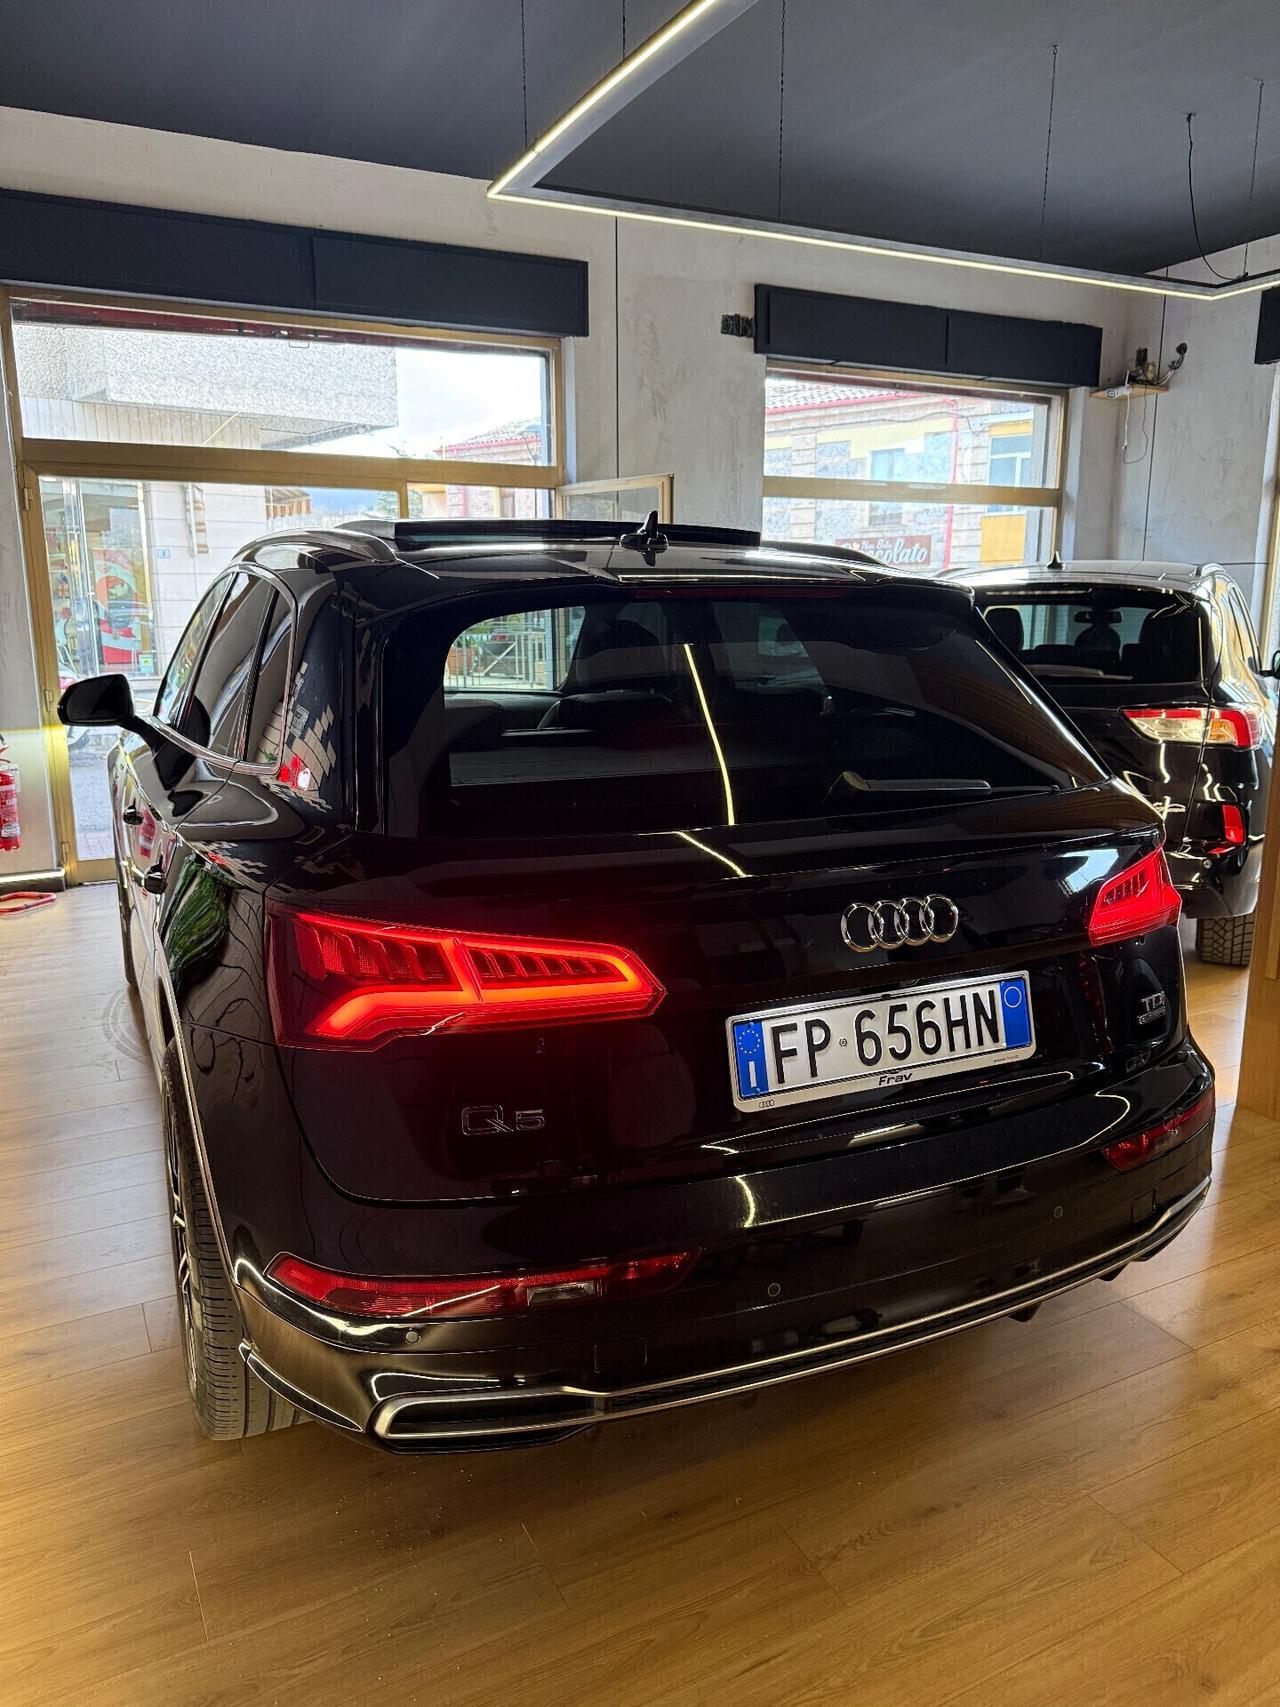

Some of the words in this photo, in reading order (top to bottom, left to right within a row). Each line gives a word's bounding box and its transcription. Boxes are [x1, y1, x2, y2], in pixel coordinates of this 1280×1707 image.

[771, 1018, 831, 1085] FP
[855, 990, 999, 1067] 656HN
[878, 1073, 913, 1086] Frav
[461, 1105, 545, 1136] Q5
